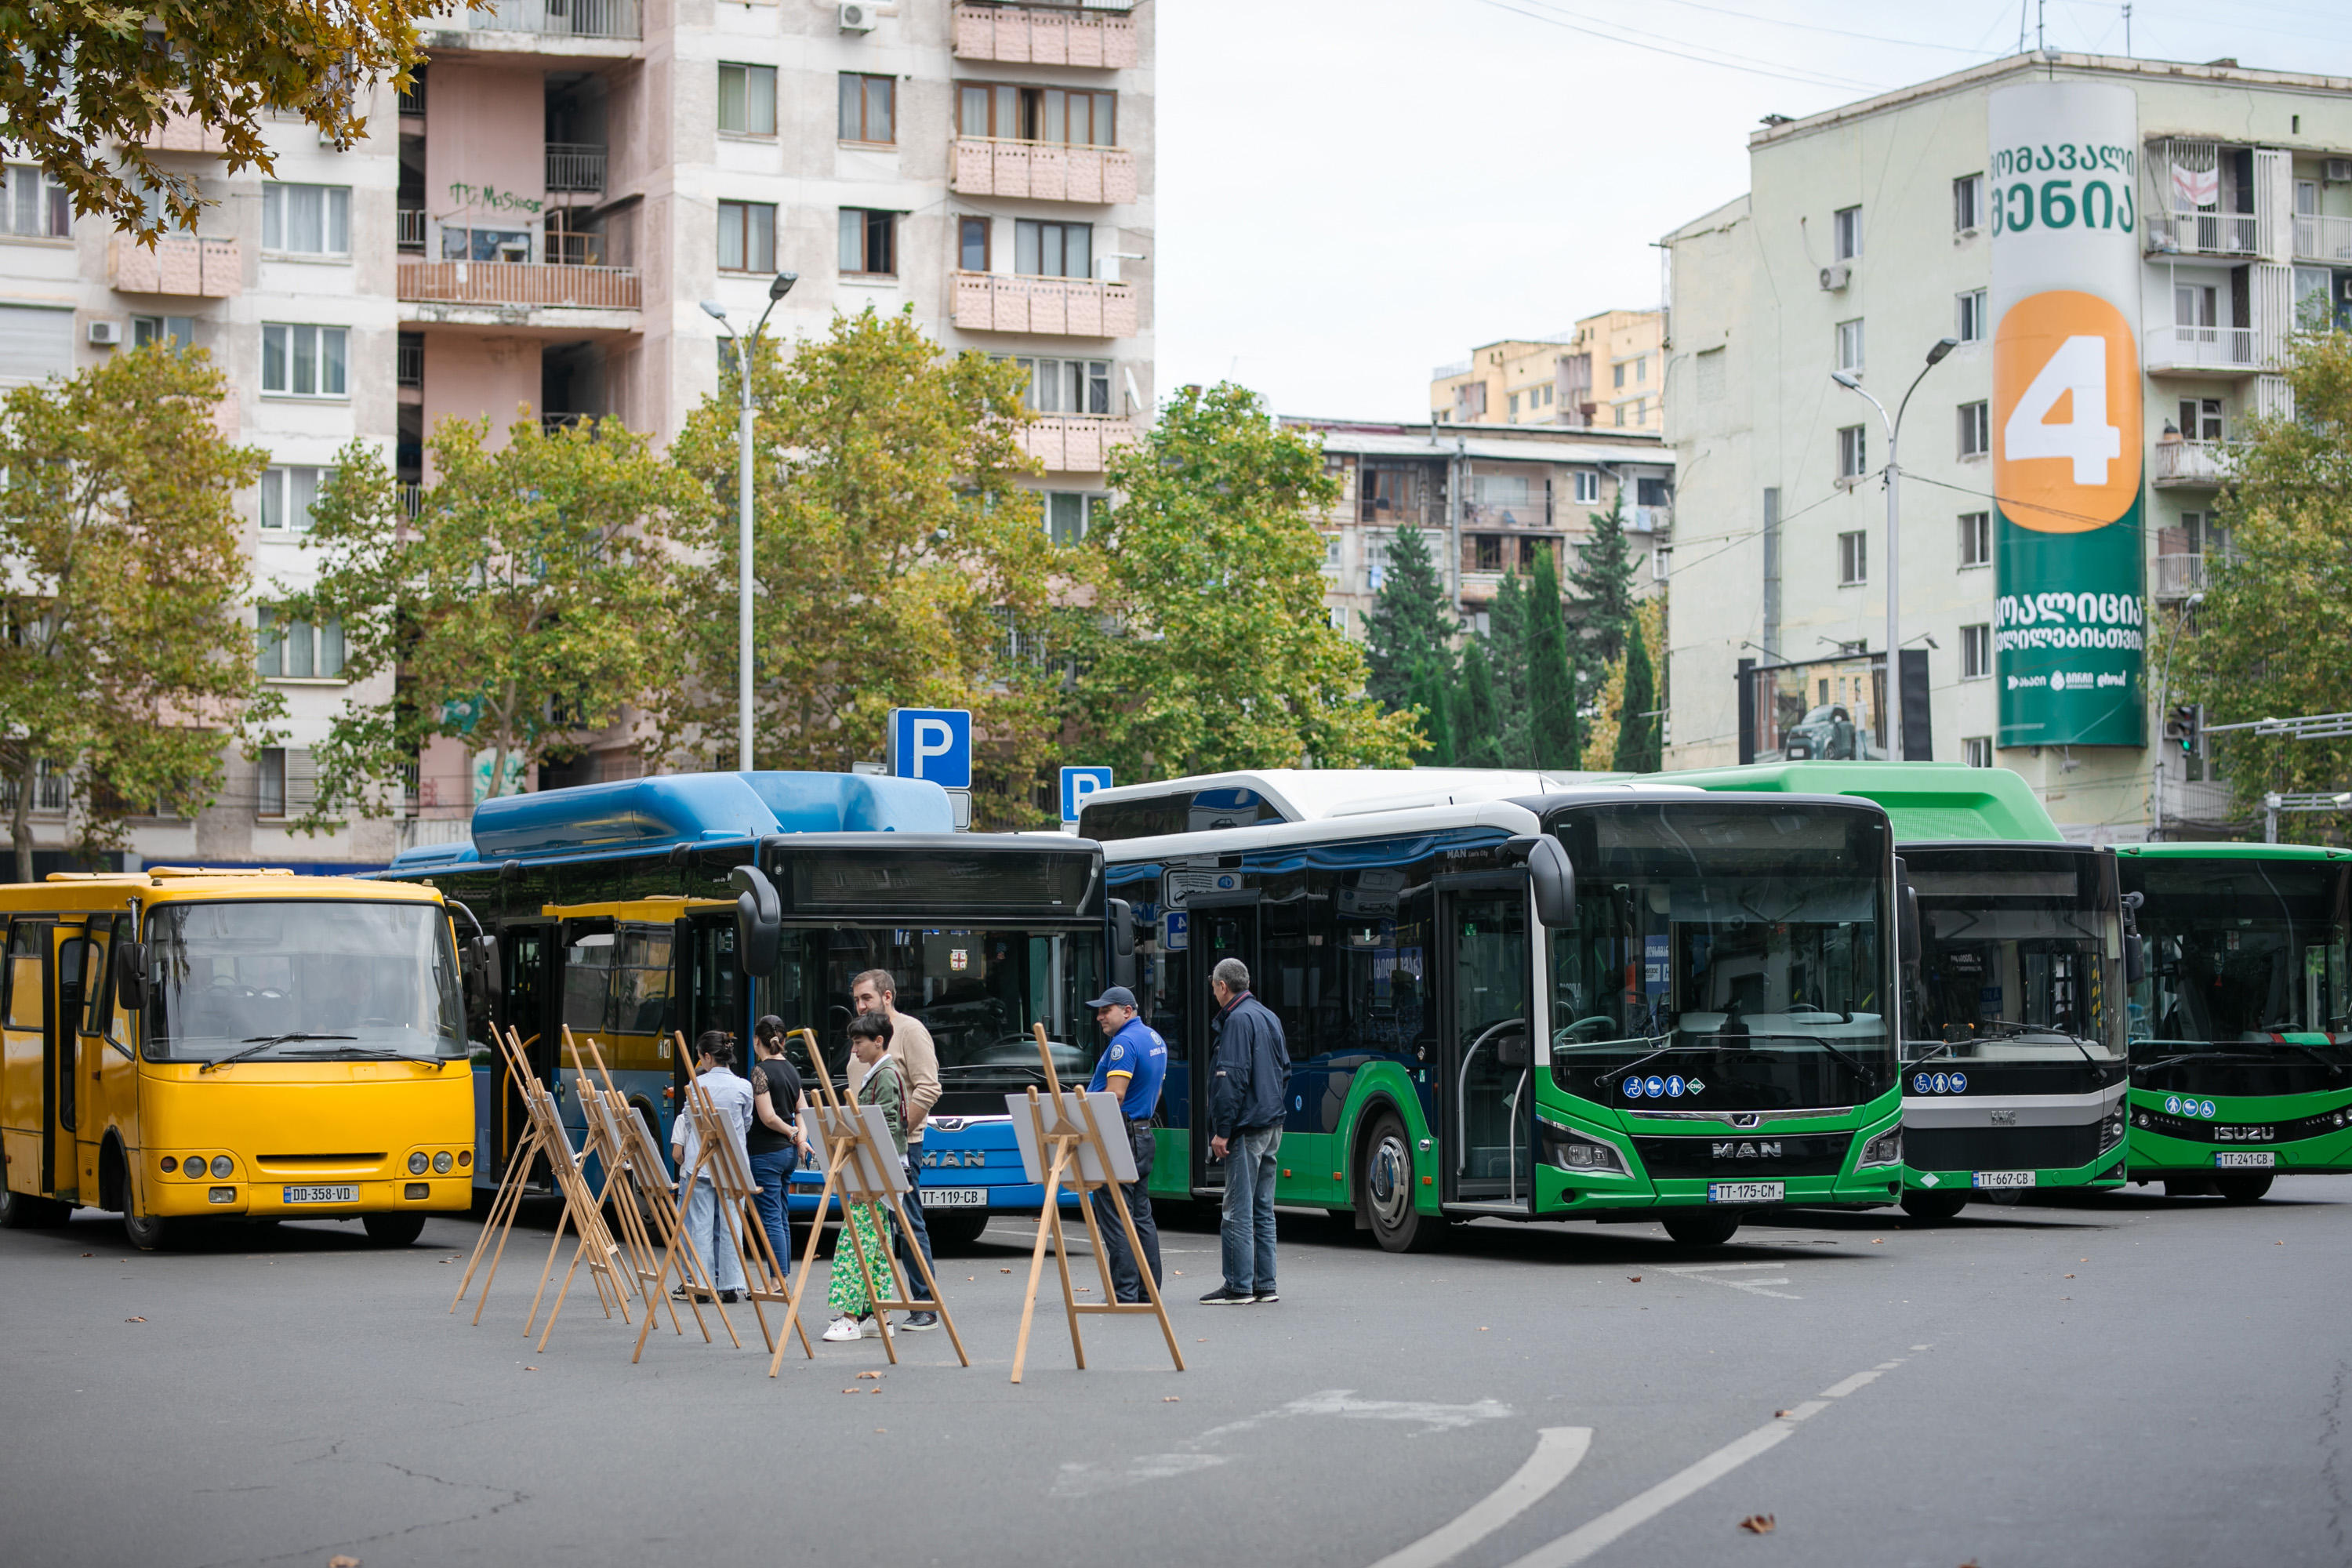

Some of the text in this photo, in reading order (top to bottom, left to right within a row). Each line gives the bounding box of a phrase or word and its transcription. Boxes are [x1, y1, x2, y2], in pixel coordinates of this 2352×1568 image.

[2005, 335, 2121, 485] 4
[1995, 626, 2143, 653] ვლილებისთვის
[913, 718, 954, 779] P
[1072, 773, 1102, 816] P
[1446, 848, 1467, 859] MAN
[2214, 1127, 2274, 1141] ISUZU
[1712, 1142, 1782, 1159] MAN
[921, 1151, 985, 1167] MAN
[2223, 1153, 2268, 1165] TT-241-CB
[1980, 1173, 2029, 1185] TT-667-CB
[293, 1187, 350, 1201] DD-358-VD
[921, 1190, 978, 1204] TT-119-CB
[1719, 1184, 1775, 1199] TT-175-CM
